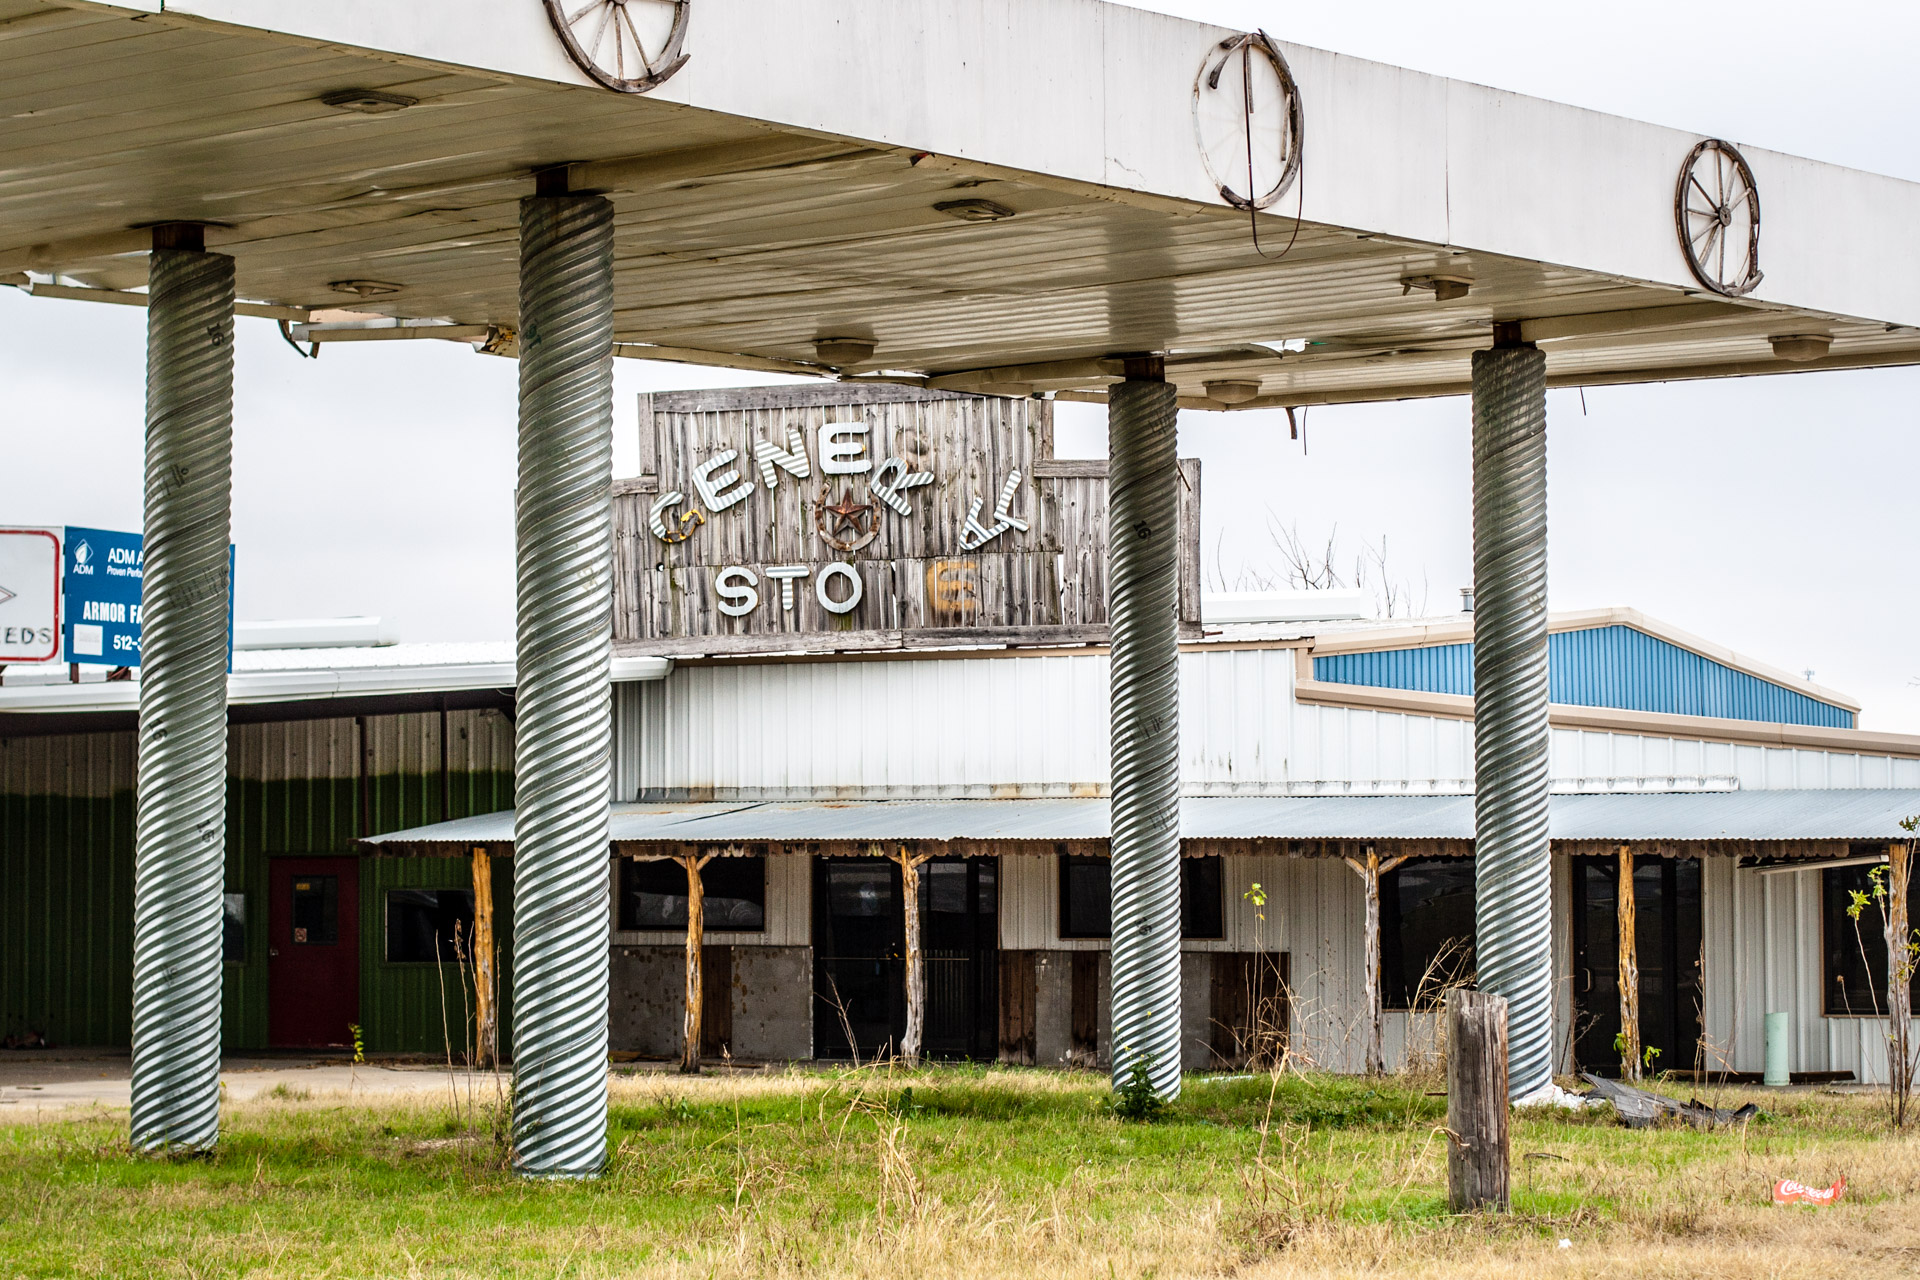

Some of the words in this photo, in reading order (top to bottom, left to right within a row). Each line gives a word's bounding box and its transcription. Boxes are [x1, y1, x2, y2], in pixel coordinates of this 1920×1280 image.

[649, 421, 1030, 551] GENERAL
[107, 547, 136, 565] ADM
[72, 563, 94, 576] ADM
[106, 565, 127, 577] Proven
[715, 561, 978, 617] STOE
[83, 600, 126, 623] ARMOR
[0, 626, 53, 645] EDS
